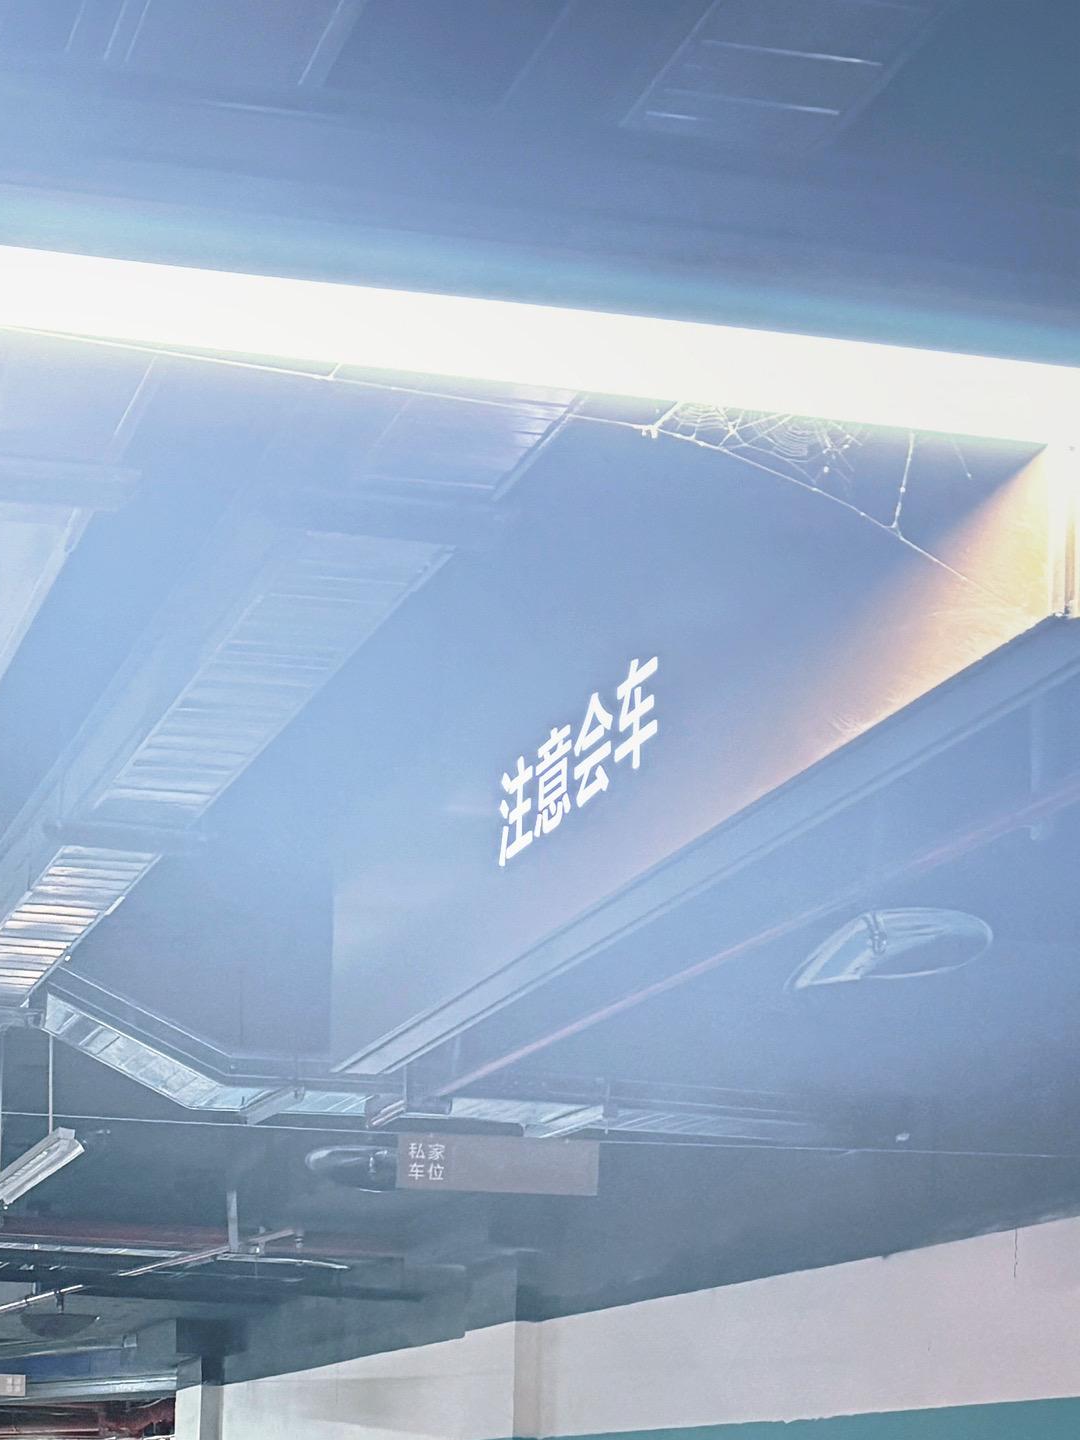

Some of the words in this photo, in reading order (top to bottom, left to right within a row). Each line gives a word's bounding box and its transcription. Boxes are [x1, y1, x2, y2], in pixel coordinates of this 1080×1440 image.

[498, 656, 658, 867] 注意会车
[408, 1142, 446, 1161] 私家
[408, 1163, 445, 1181] 车位
